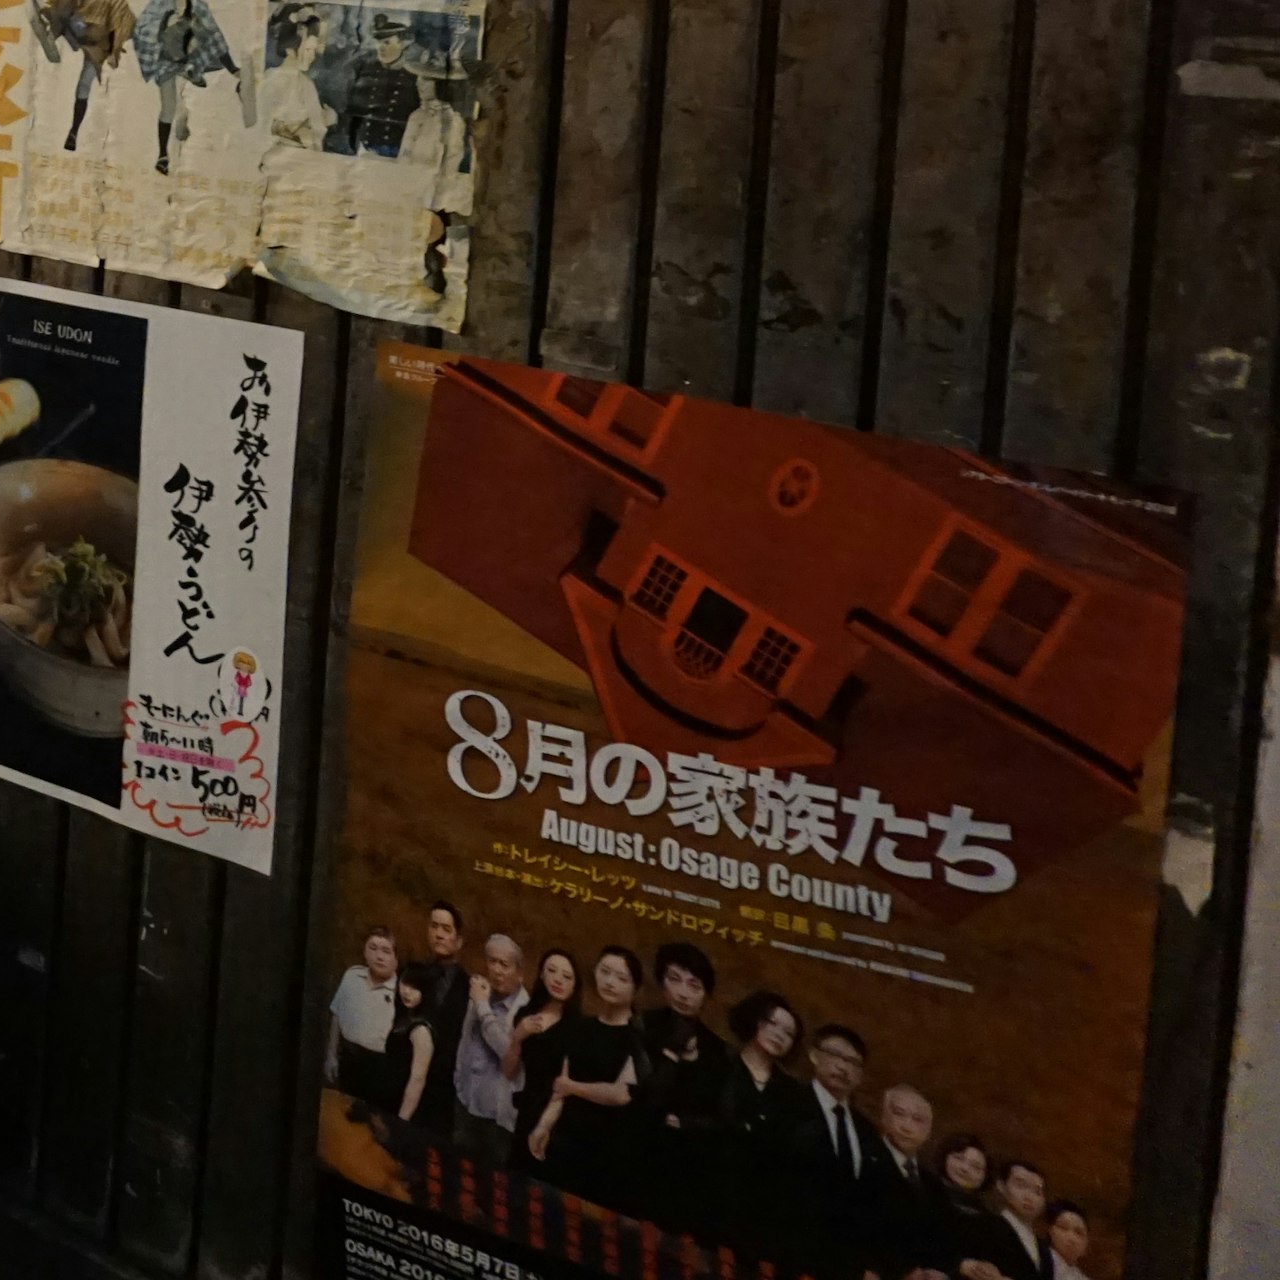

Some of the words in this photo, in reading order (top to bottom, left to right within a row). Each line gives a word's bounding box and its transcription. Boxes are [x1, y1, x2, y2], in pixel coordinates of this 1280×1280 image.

[33, 319, 53, 336] ISE
[57, 324, 93, 345] UDON
[229, 352, 272, 572] お伊勢参りの
[163, 462, 226, 665] 伊勢うどん
[443, 689, 1019, 894] 8月の家族たち
[659, 835, 761, 891] Osage
[767, 862, 893, 924] County
[342, 1198, 394, 1229] TOKYO
[344, 1239, 396, 1270] OSAKA
